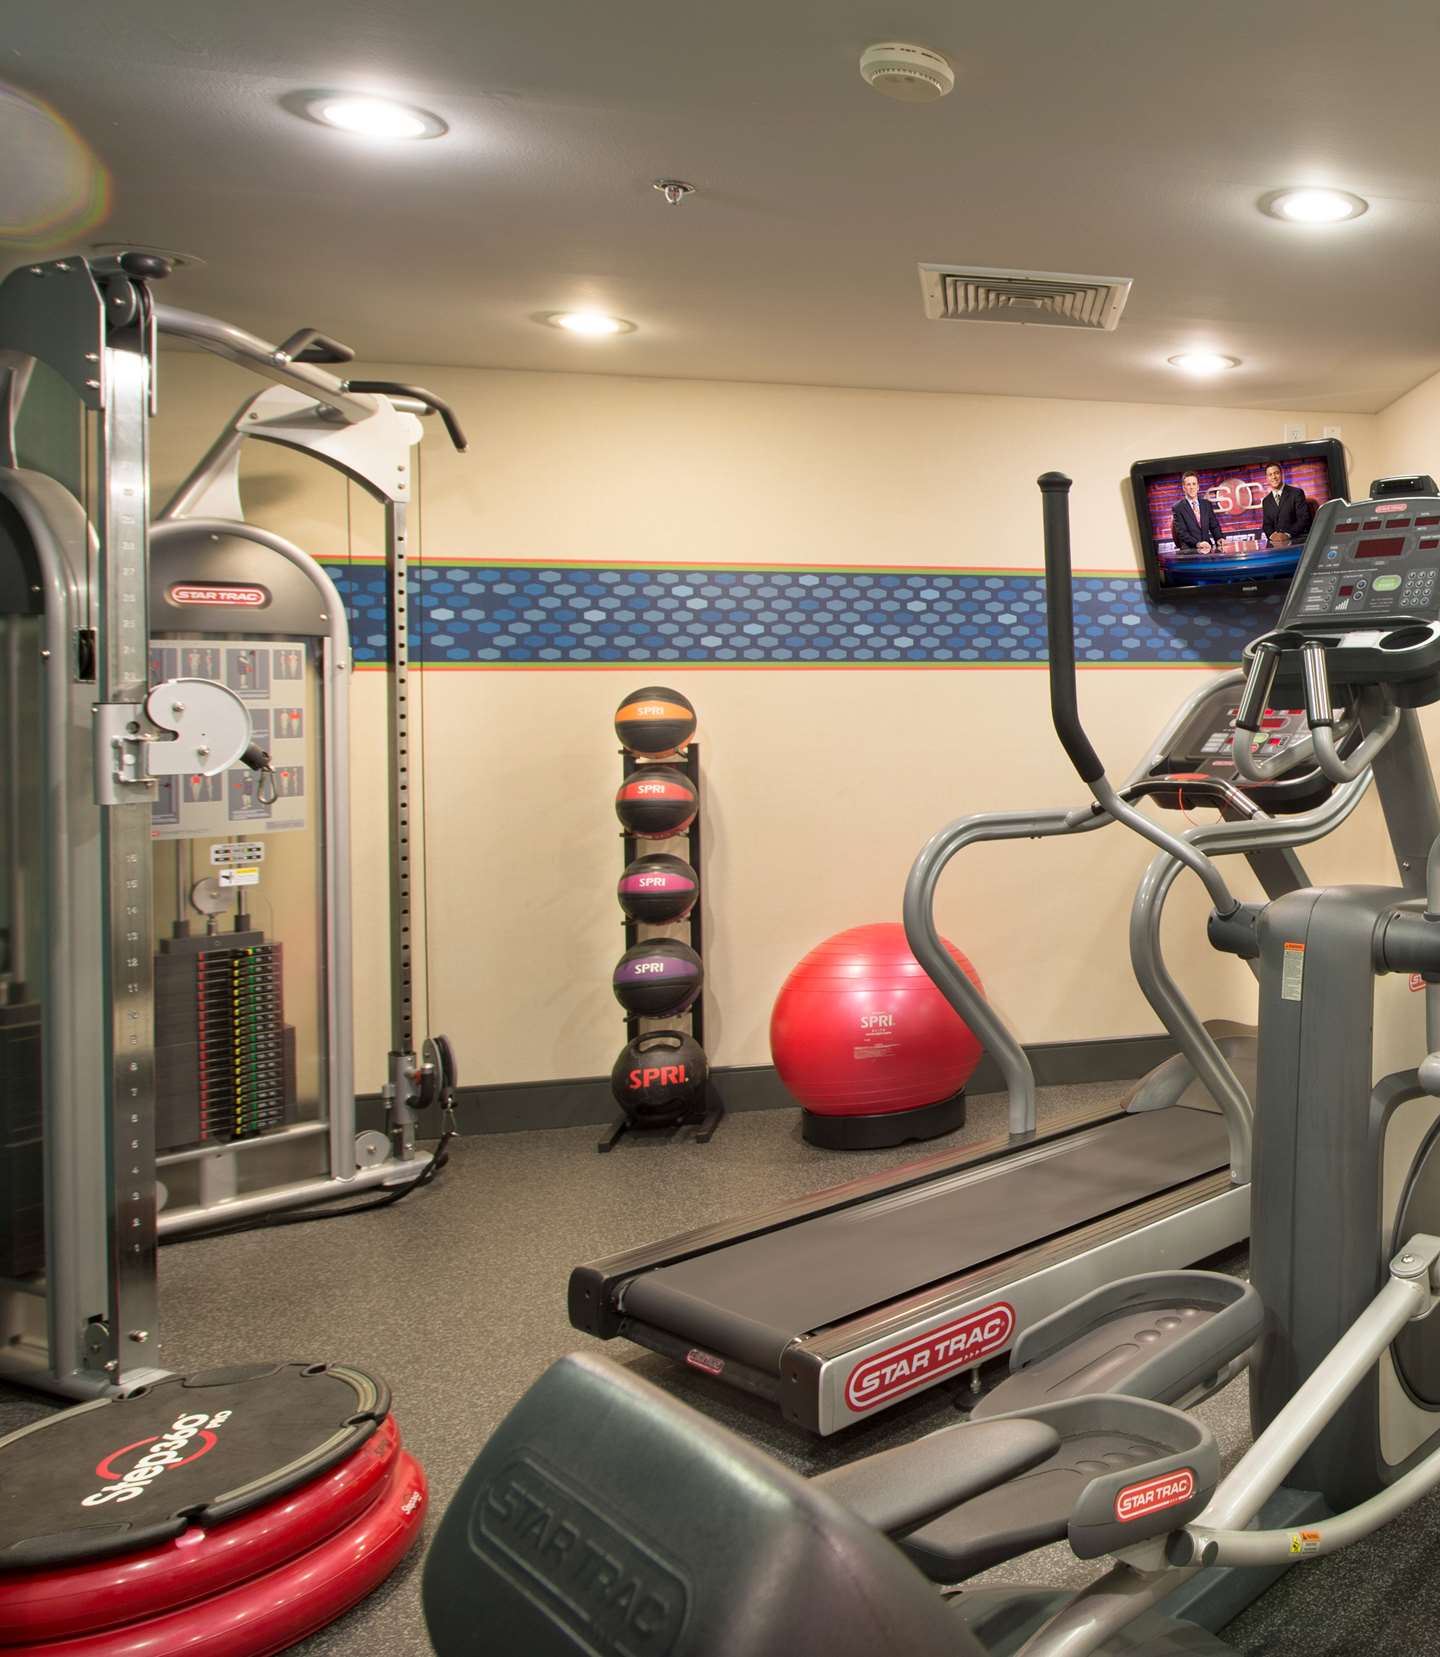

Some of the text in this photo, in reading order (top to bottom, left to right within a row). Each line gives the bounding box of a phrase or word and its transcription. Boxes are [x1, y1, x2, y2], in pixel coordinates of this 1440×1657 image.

[178, 591, 258, 601] STAR TRAC
[637, 706, 665, 716] SPRI
[638, 784, 665, 794] SPRI
[639, 876, 666, 888] SPRI
[634, 962, 665, 975] SPRI
[860, 1014, 893, 1029] SPRI
[629, 1064, 686, 1089] SPRI
[861, 1318, 1002, 1396] STAR TRAC
[1123, 1480, 1187, 1511] STAR TRAC
[489, 1481, 670, 1636] STAR TRAC
